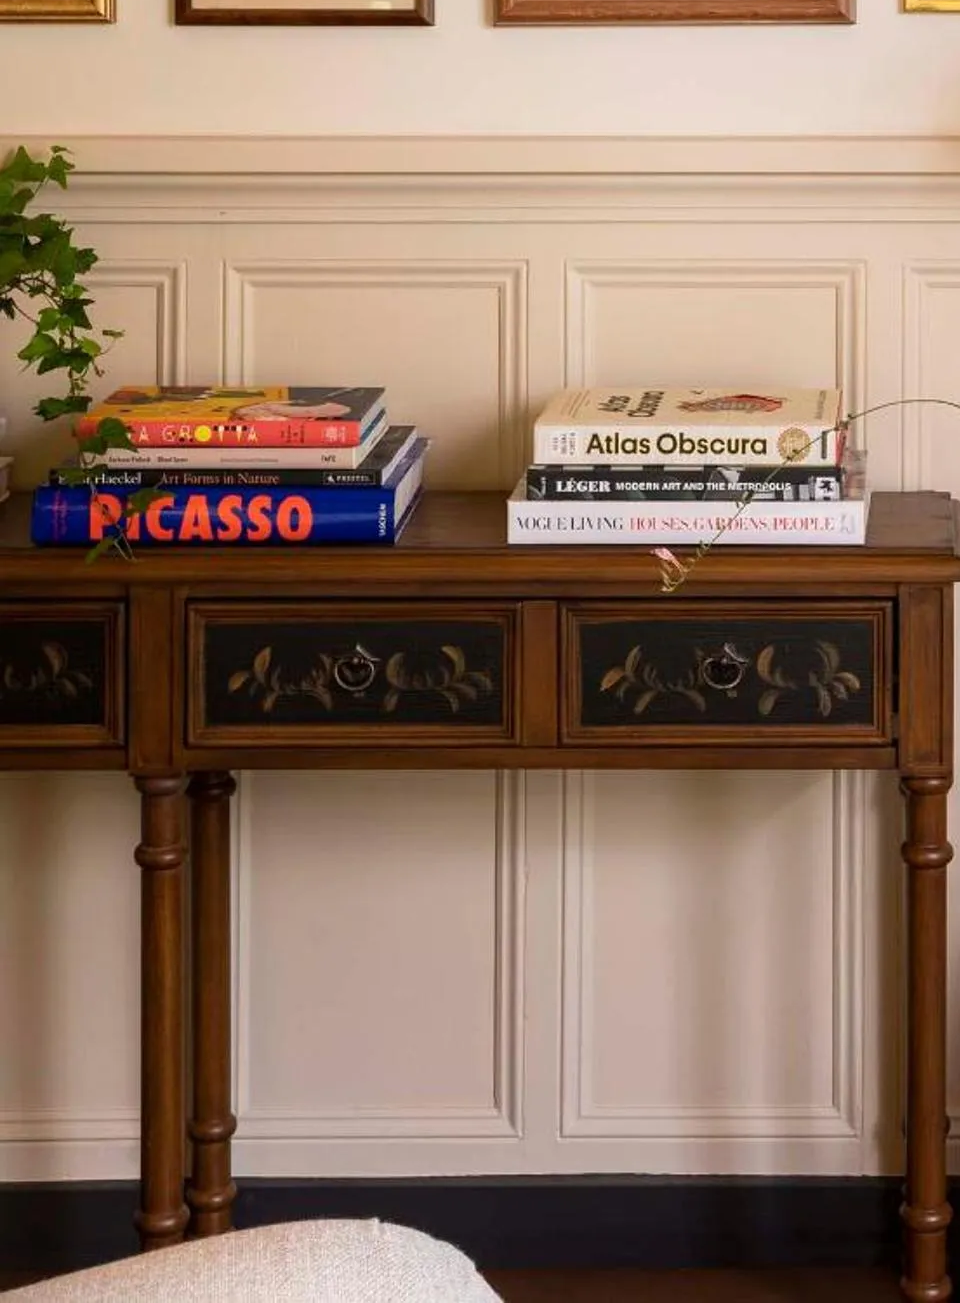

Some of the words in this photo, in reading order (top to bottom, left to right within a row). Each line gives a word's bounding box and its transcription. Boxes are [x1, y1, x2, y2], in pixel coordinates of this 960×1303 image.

[162, 424, 258, 443] GROTTA
[586, 432, 651, 455] Atlas
[656, 432, 767, 455] Obscura
[94, 472, 142, 485] Haeckel
[160, 472, 179, 485] Art
[184, 472, 220, 485] Forms
[223, 472, 234, 485] in
[238, 472, 280, 485] Nature
[556, 477, 611, 493] LÉGER
[615, 482, 660, 491] MODERN
[661, 482, 680, 491] ART
[682, 482, 705, 491] AND
[706, 482, 726, 491] THE
[727, 482, 792, 491] METROPOLIS
[89, 494, 314, 541] PICASSO
[516, 516, 567, 531] VOGUE
[570, 516, 624, 531] LIVING
[773, 516, 835, 531] PEOPLE
